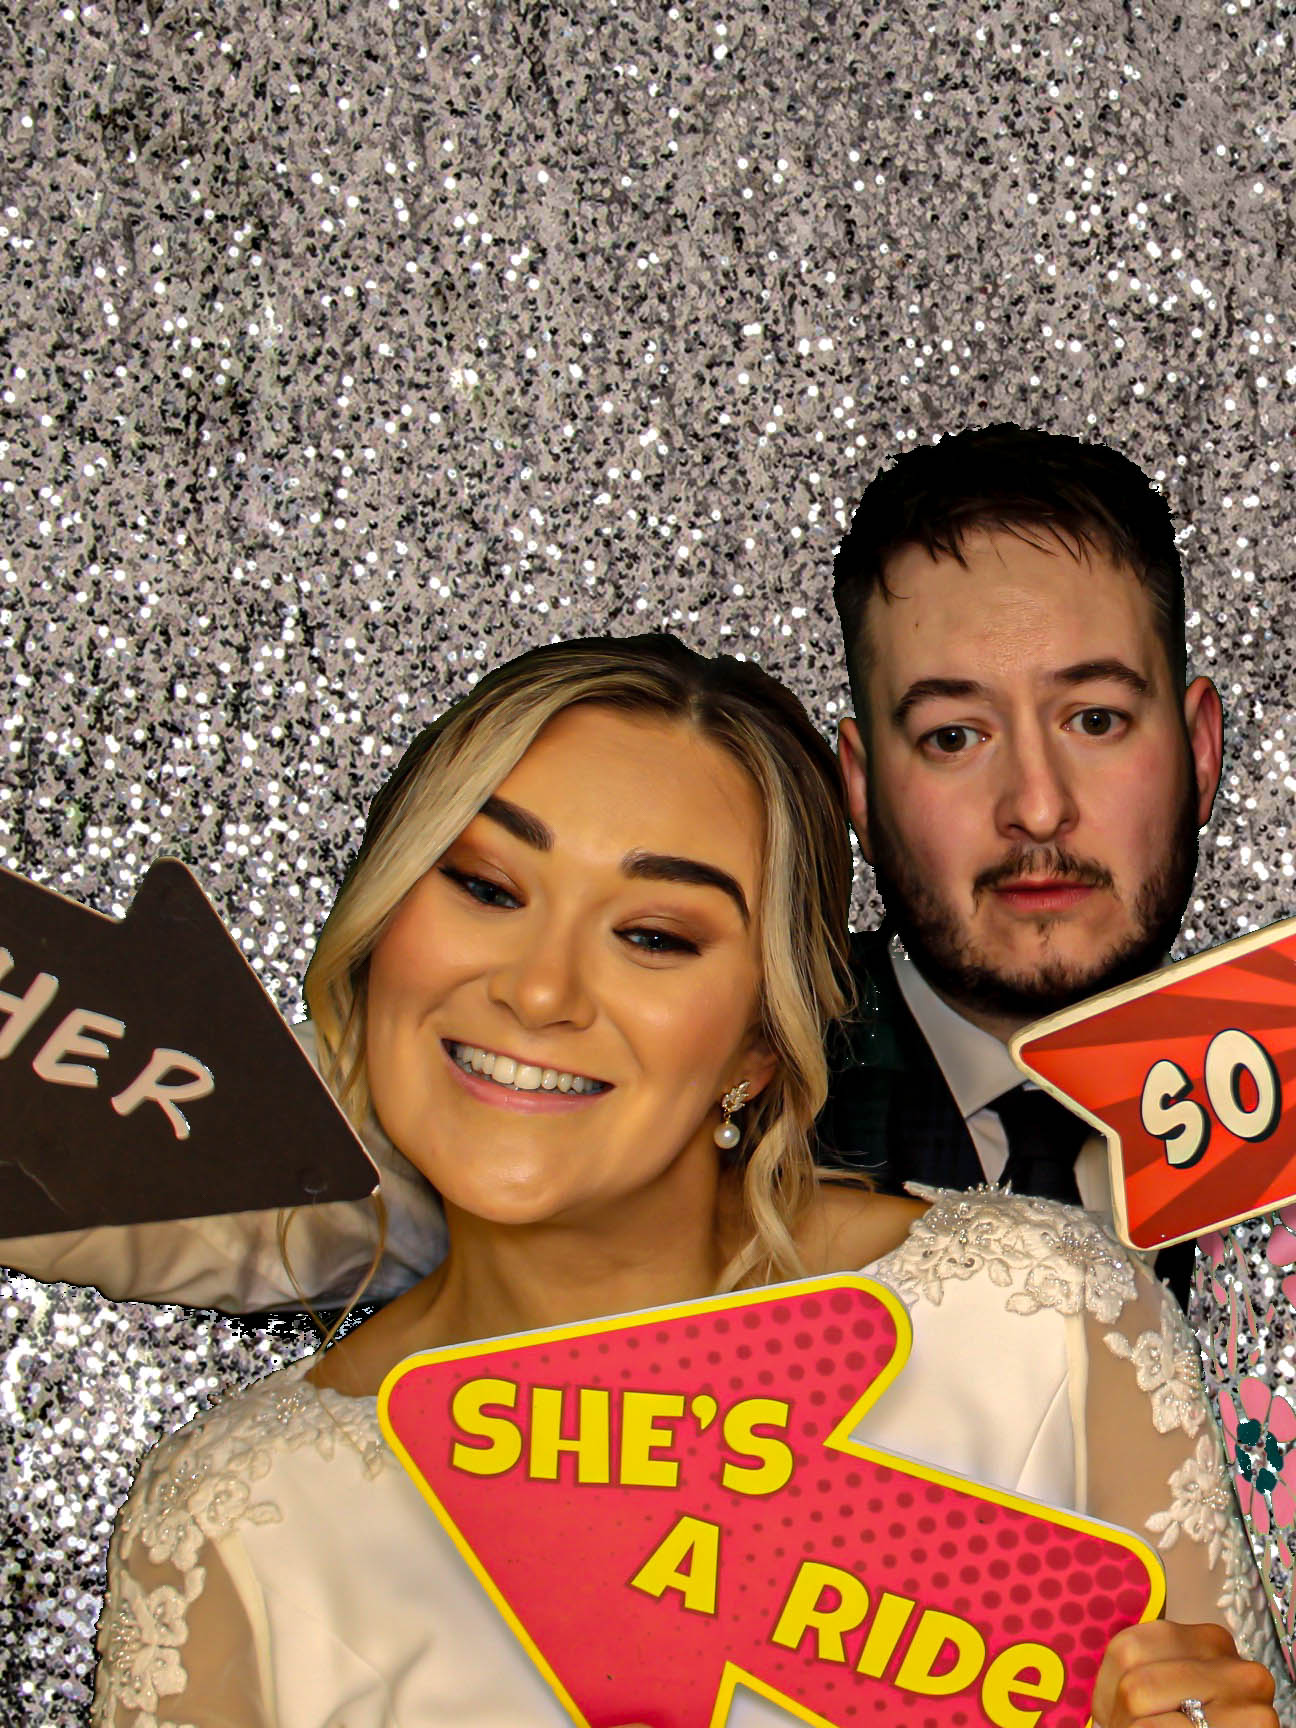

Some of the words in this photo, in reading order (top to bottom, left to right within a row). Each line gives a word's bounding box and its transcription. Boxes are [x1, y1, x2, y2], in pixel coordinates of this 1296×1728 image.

[1139, 1027, 1283, 1169] SO
[451, 1377, 794, 1496] SHE'S
[630, 1515, 720, 1615] A
